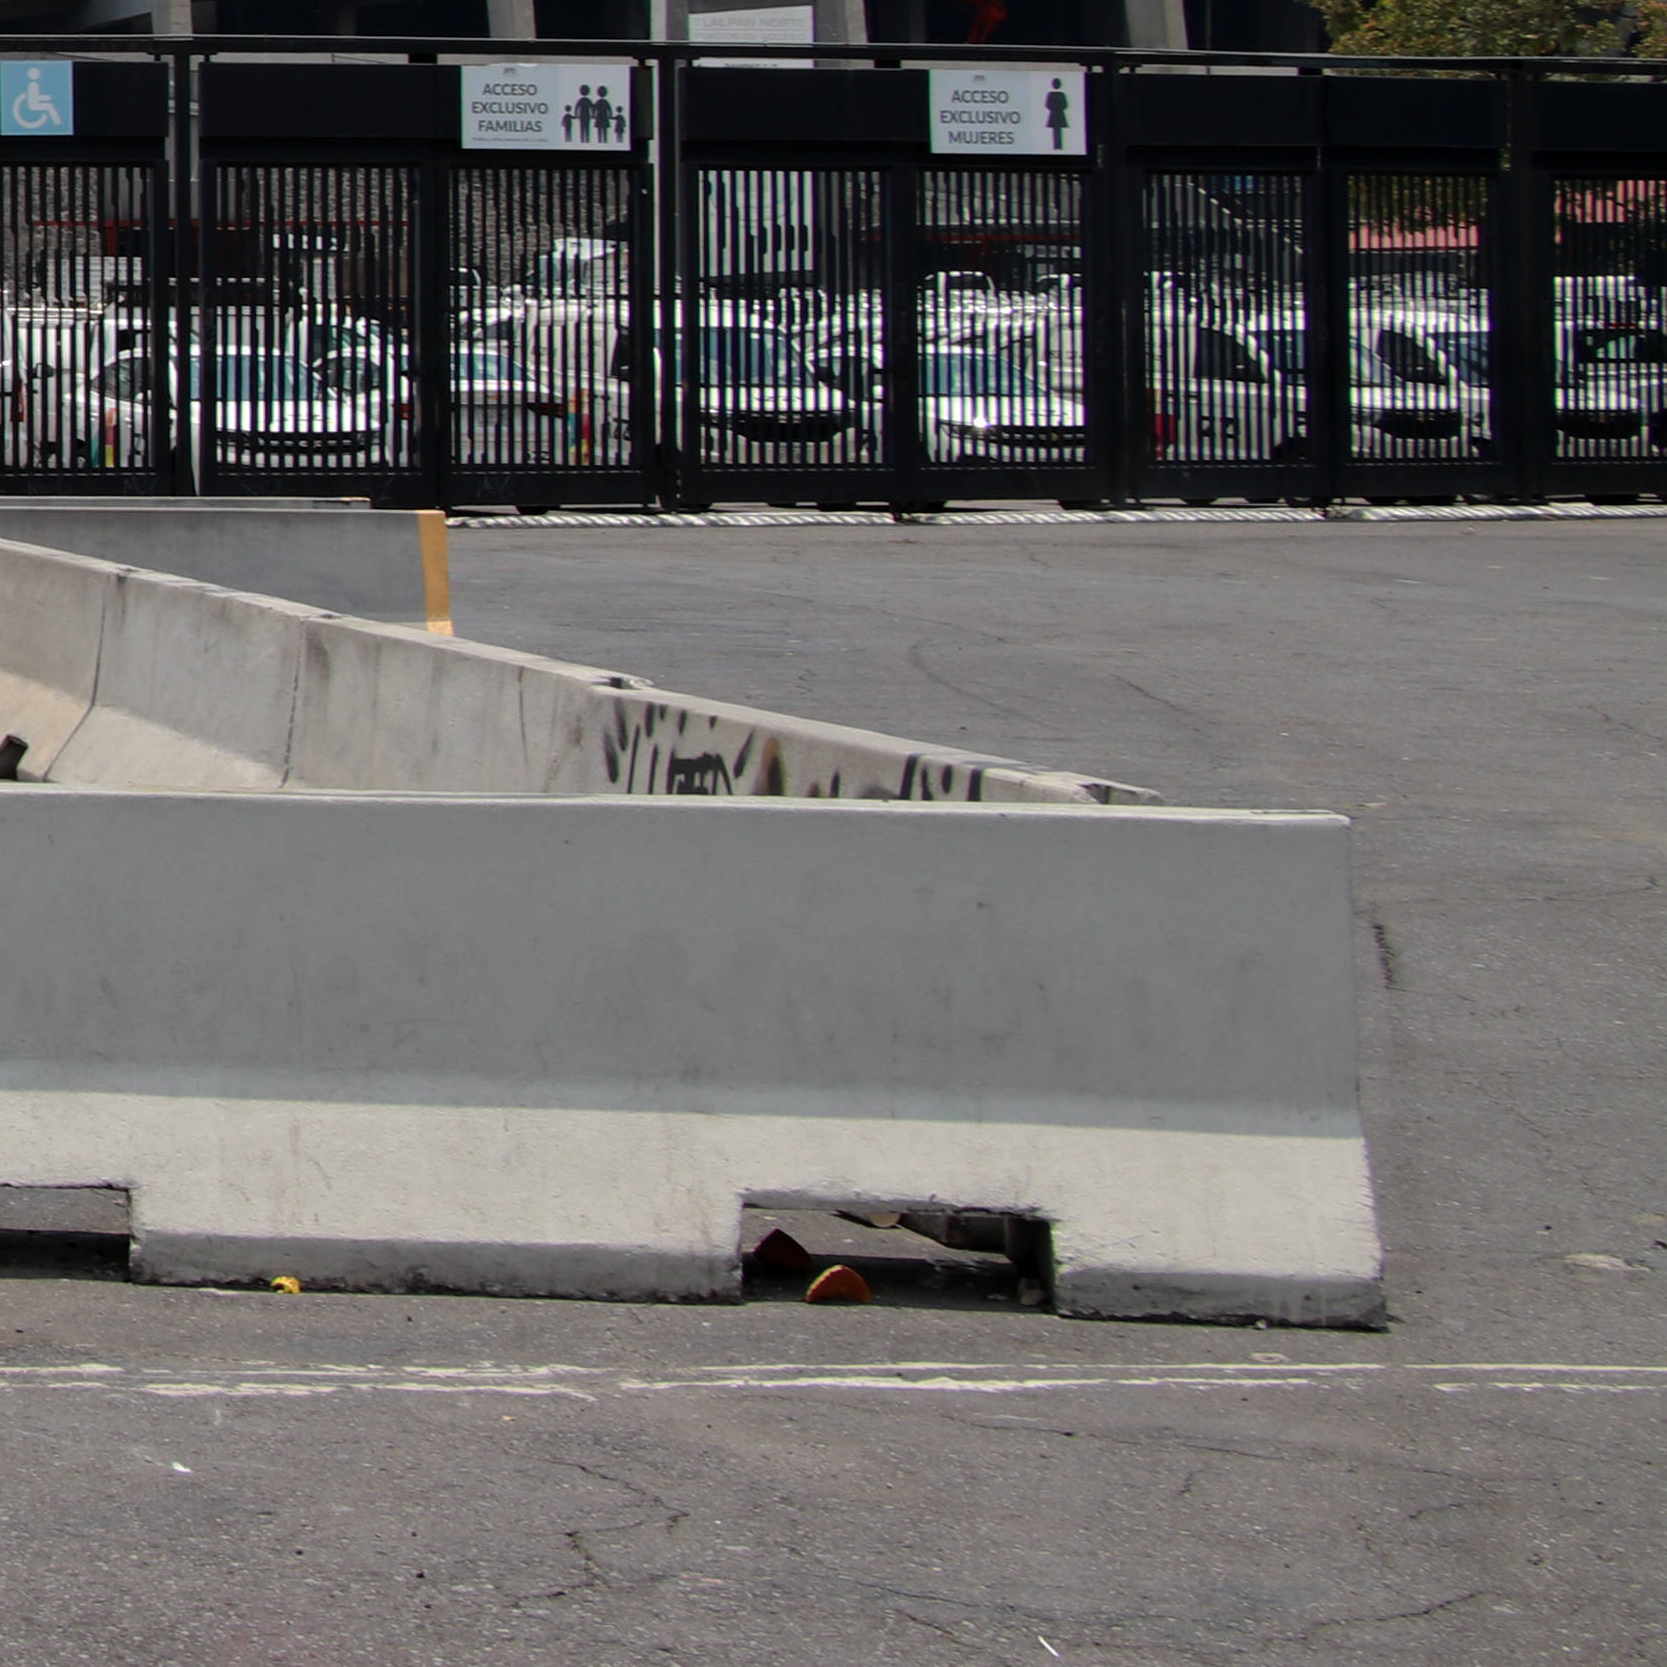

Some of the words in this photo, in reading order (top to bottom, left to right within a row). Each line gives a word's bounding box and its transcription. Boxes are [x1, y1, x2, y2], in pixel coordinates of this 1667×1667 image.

[482, 83, 538, 96] ACCESO
[950, 90, 1010, 104] ACCESO
[471, 101, 549, 115] EXCLUSIVO
[939, 110, 1021, 125] EXCLUSIVO
[477, 119, 543, 133] FAMILIAS
[948, 130, 1015, 145] MUJERES
